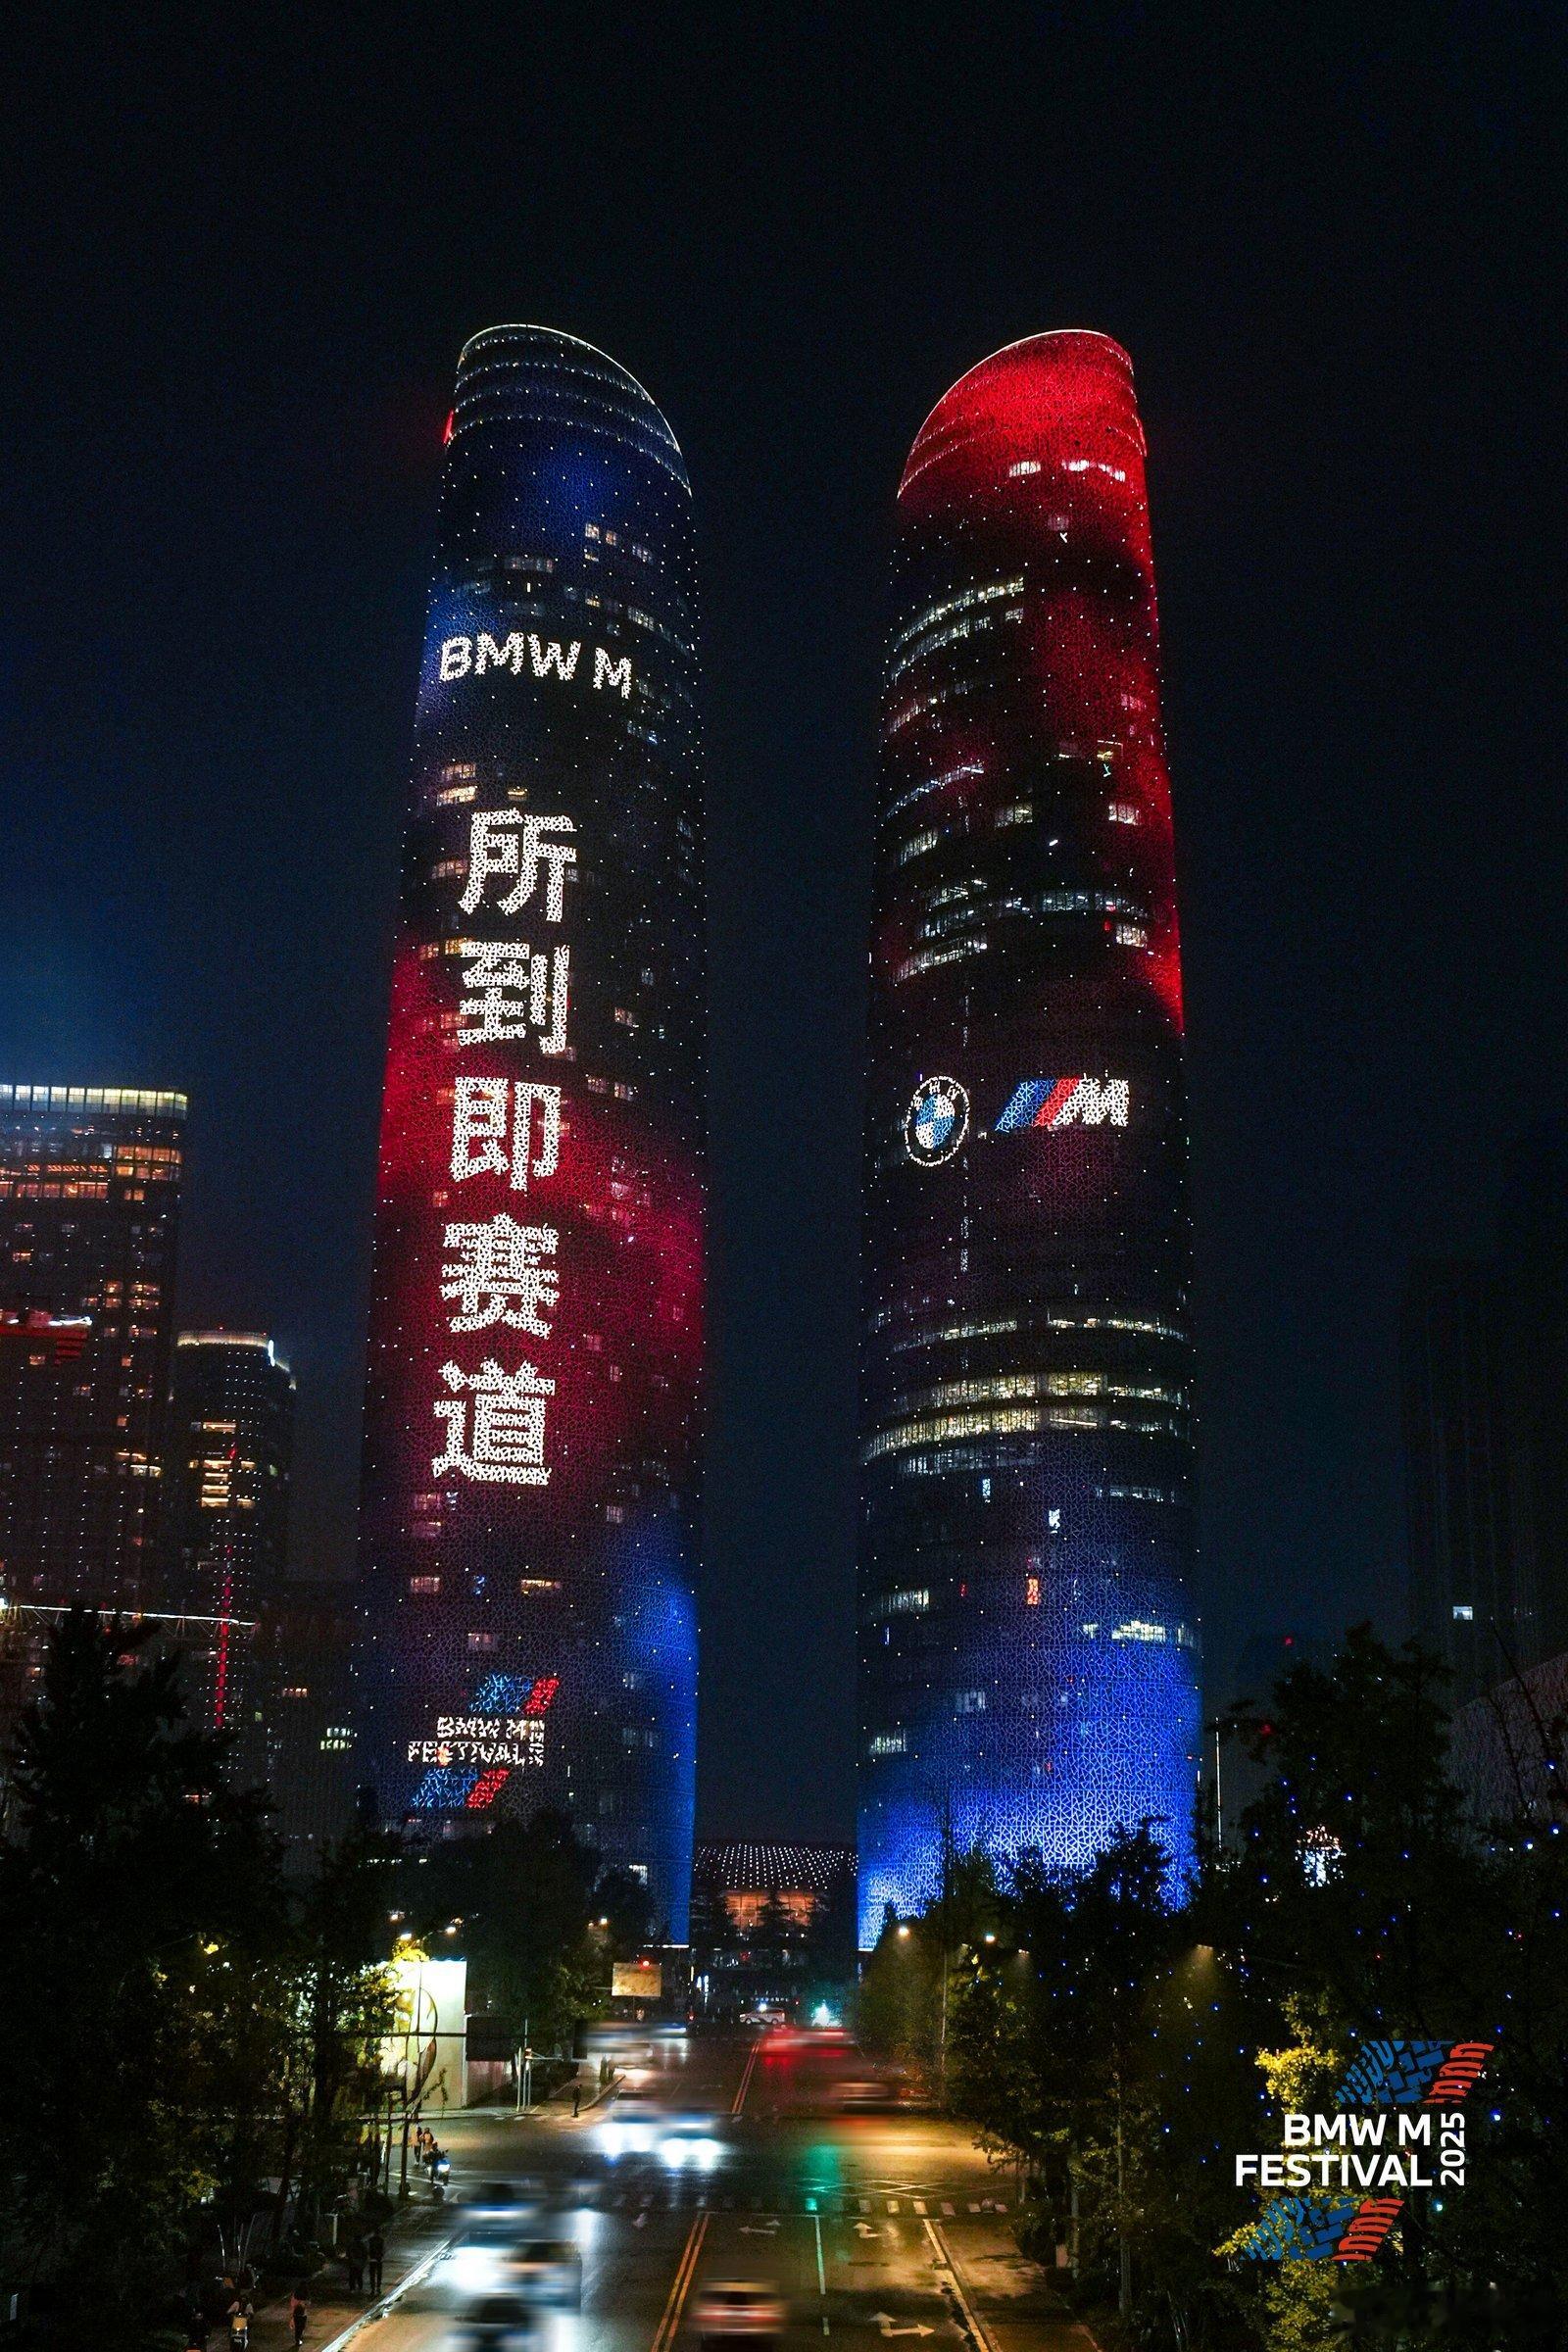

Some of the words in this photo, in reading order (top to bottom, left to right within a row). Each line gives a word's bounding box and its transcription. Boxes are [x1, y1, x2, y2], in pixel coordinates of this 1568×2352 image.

[440, 632, 581, 682] BMW
[593, 647, 632, 699] M
[431, 808, 578, 1487] 所到即赛道
